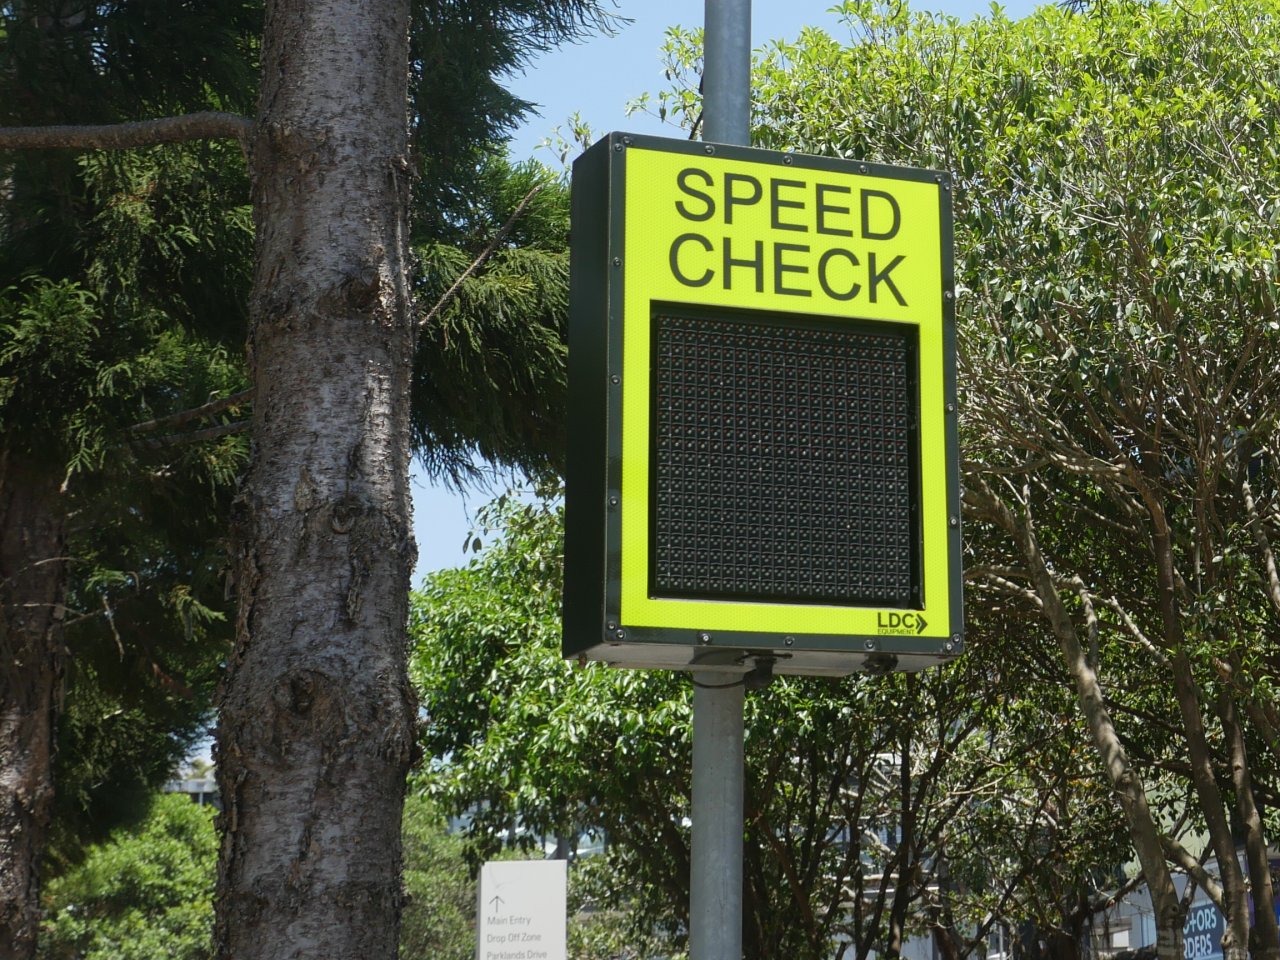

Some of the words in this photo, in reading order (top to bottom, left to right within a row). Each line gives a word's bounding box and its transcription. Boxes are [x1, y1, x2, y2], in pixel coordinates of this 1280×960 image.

[675, 167, 901, 241] SPEED
[668, 232, 908, 307] CHECK
[877, 612, 915, 629] LDC
[487, 916, 508, 926] Main
[509, 915, 532, 926] Entry
[486, 934, 506, 944] Drop
[507, 932, 521, 942] Off
[522, 932, 542, 942] Zone
[487, 951, 525, 960] Parklands
[527, 950, 547, 959] Drive
